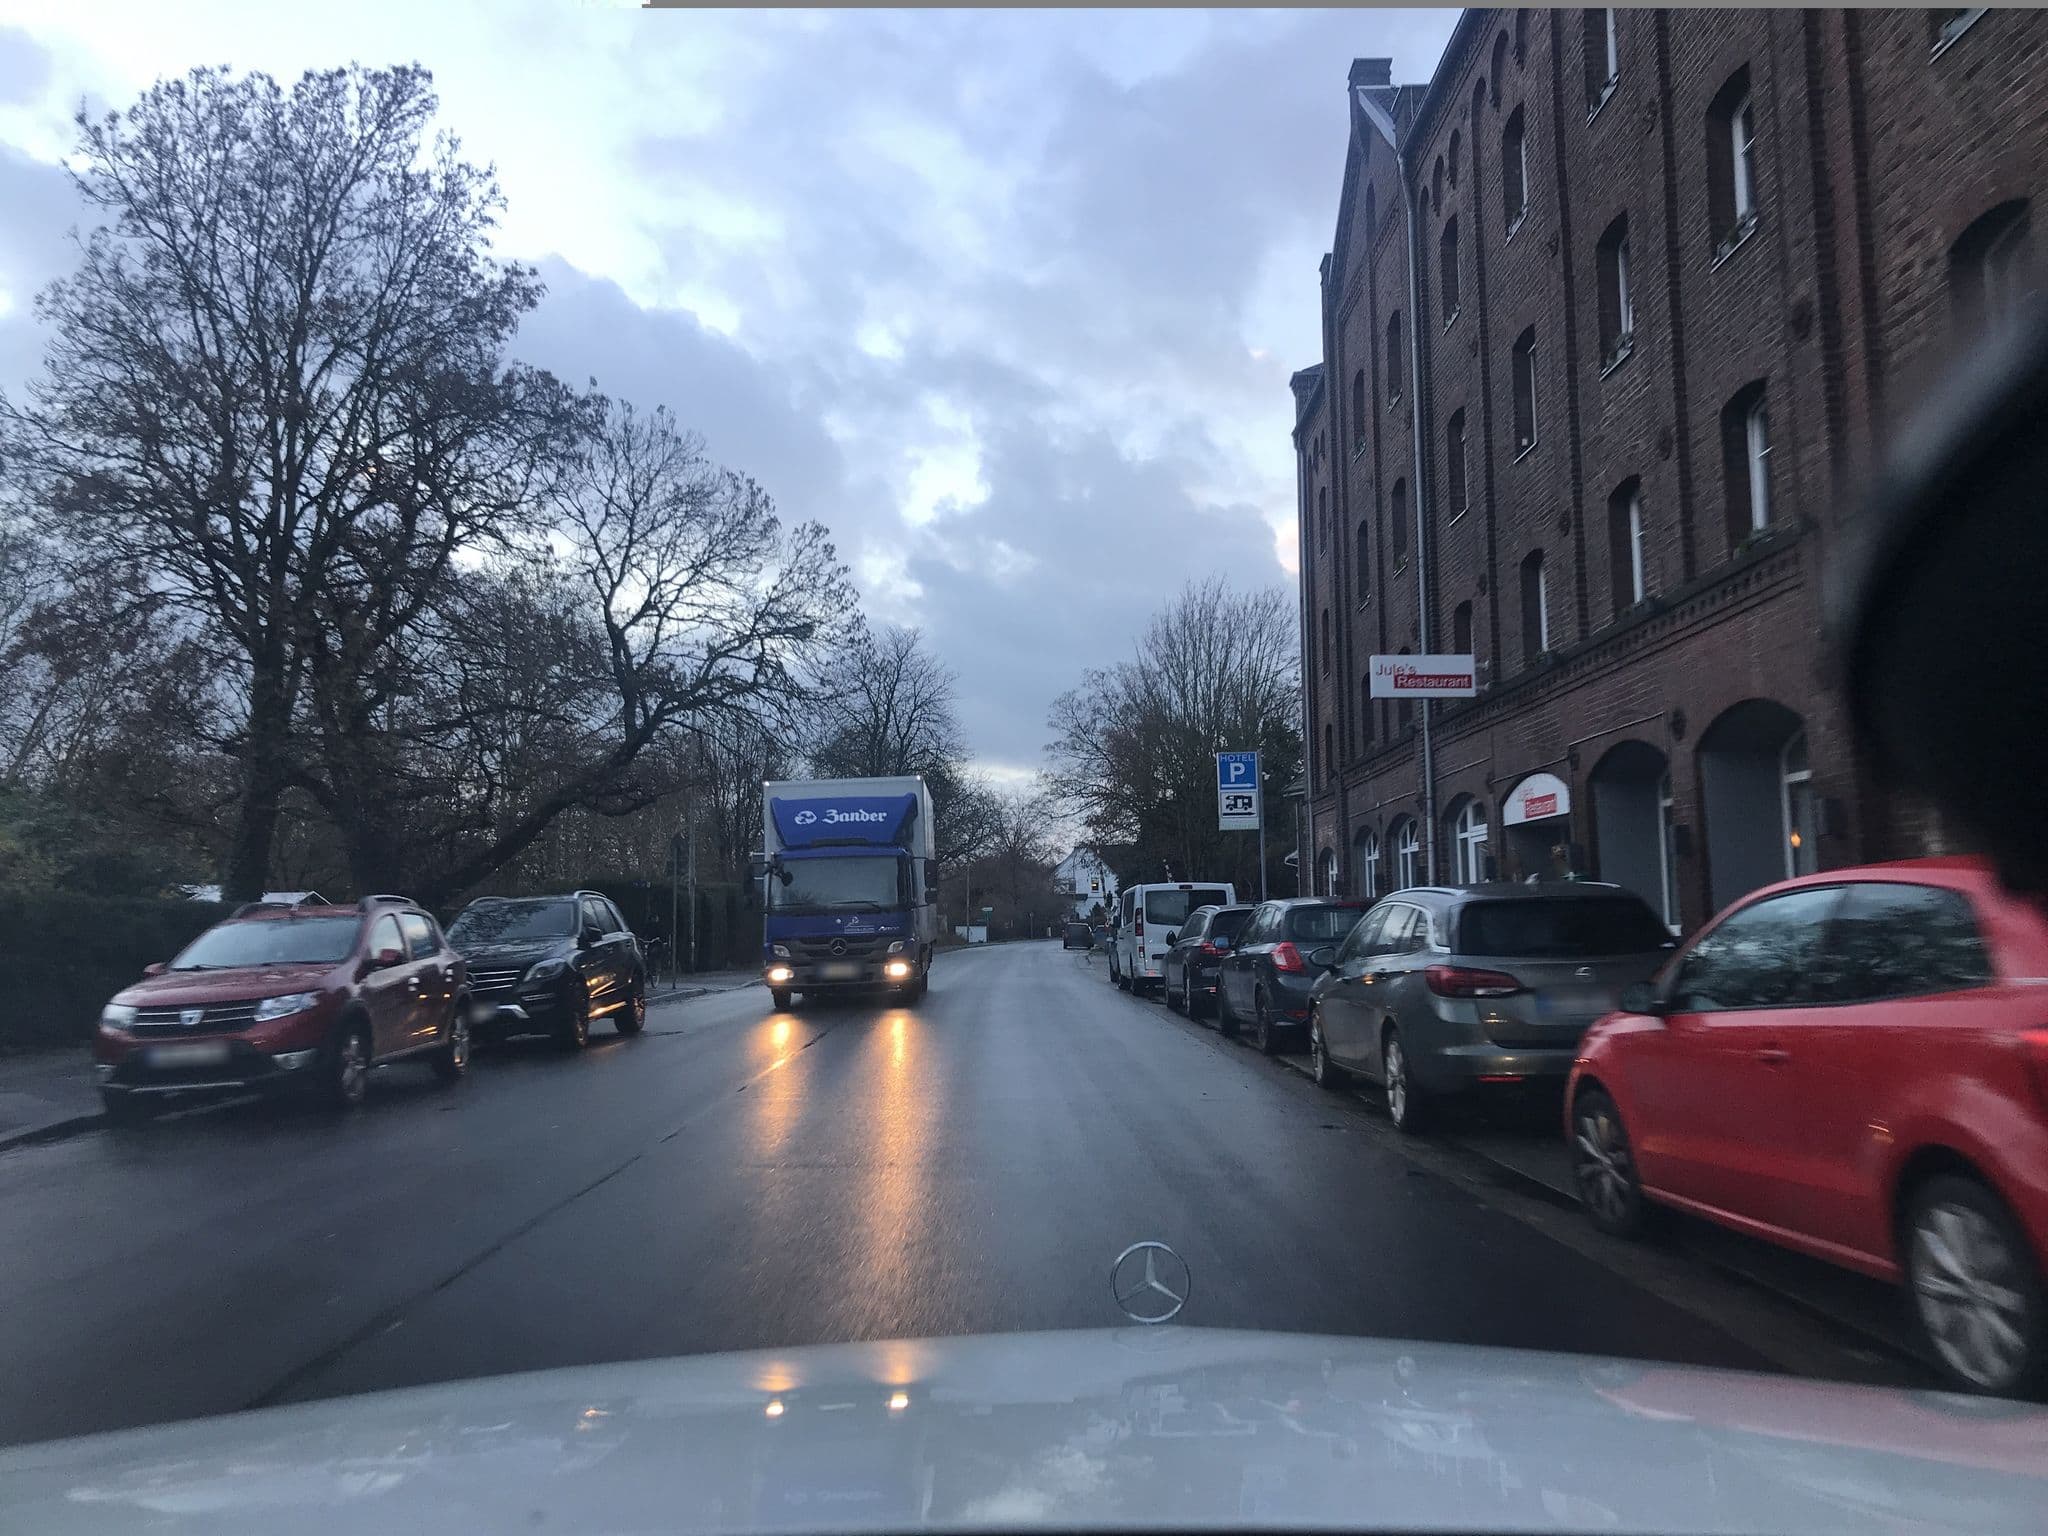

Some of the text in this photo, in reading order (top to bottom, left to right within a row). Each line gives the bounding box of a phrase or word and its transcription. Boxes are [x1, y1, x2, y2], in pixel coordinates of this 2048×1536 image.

[1376, 664, 1417, 676] Jule's
[1397, 676, 1470, 687] Restaurant
[1220, 754, 1254, 762] HOTEL
[1230, 762, 1246, 783] P
[822, 809, 887, 824] Zander
